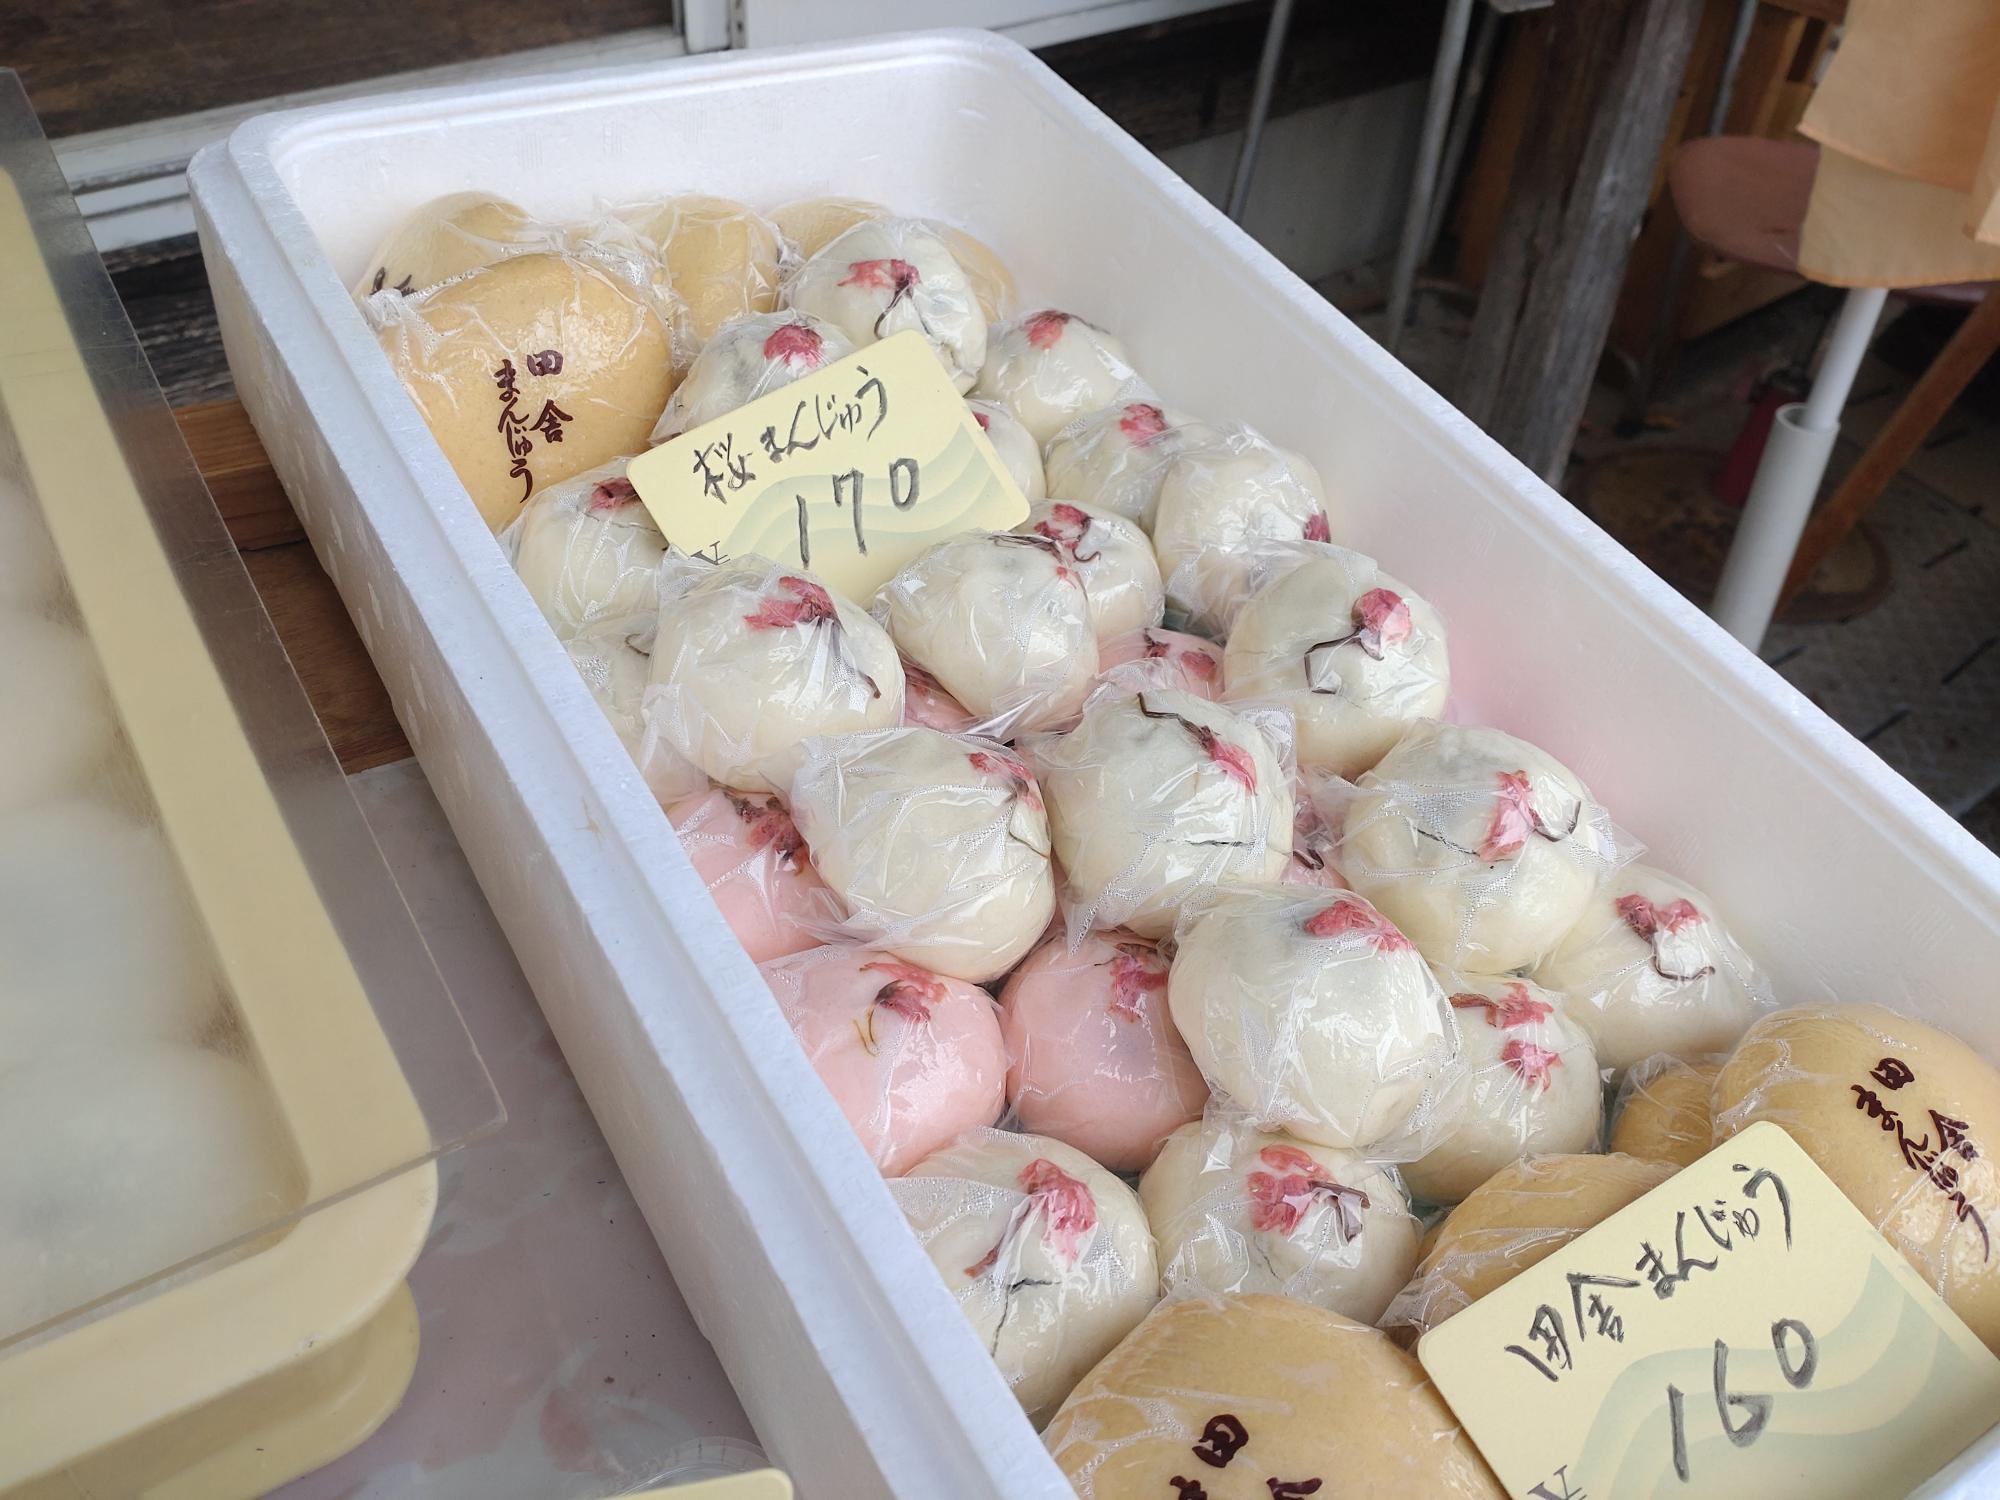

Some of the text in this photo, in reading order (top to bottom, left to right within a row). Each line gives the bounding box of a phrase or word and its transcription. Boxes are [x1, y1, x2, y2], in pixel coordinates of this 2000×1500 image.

[493, 359, 533, 504] まんじゅう
[527, 350, 573, 443] 田舎
[692, 365, 888, 505] 桜まんじゅう
[796, 457, 920, 571] 170
[1850, 1084, 1991, 1264] まんじゅう
[1869, 1057, 1980, 1163] 田舎
[1504, 1163, 1792, 1383] 田舎まんじゅう
[1667, 1317, 1818, 1482] 160
